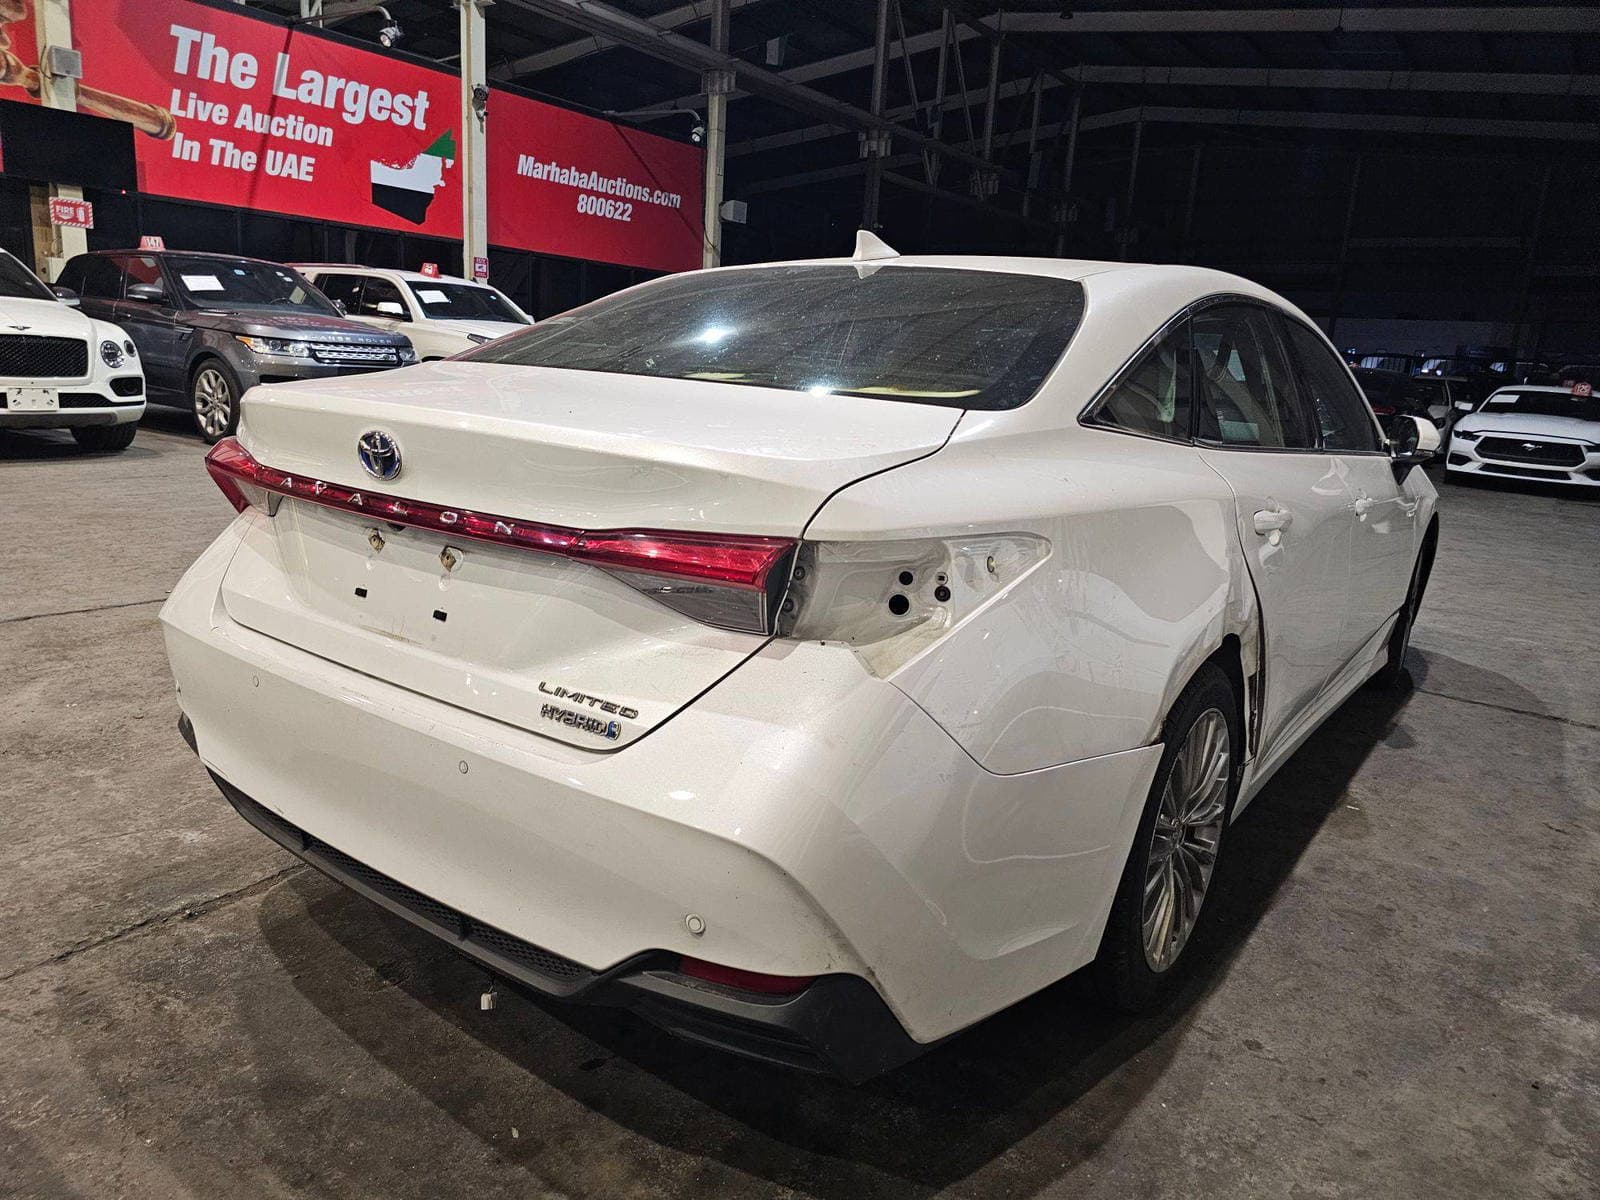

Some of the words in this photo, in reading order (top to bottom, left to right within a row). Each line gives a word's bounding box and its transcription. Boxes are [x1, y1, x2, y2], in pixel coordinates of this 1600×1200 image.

[170, 24, 258, 89] The
[273, 52, 429, 130] Largest
[170, 88, 229, 126] Live
[234, 103, 333, 147] Auction
[172, 132, 201, 162] In
[209, 138, 257, 172] The
[265, 149, 316, 182] UAE
[517, 154, 681, 208] MarhabaAuctions.com
[55, 205, 75, 216] FIRE
[577, 193, 633, 222] 800622
[280, 477, 515, 535] AVALON
[538, 681, 639, 719] LIMITED
[540, 703, 608, 735] HYBRID
